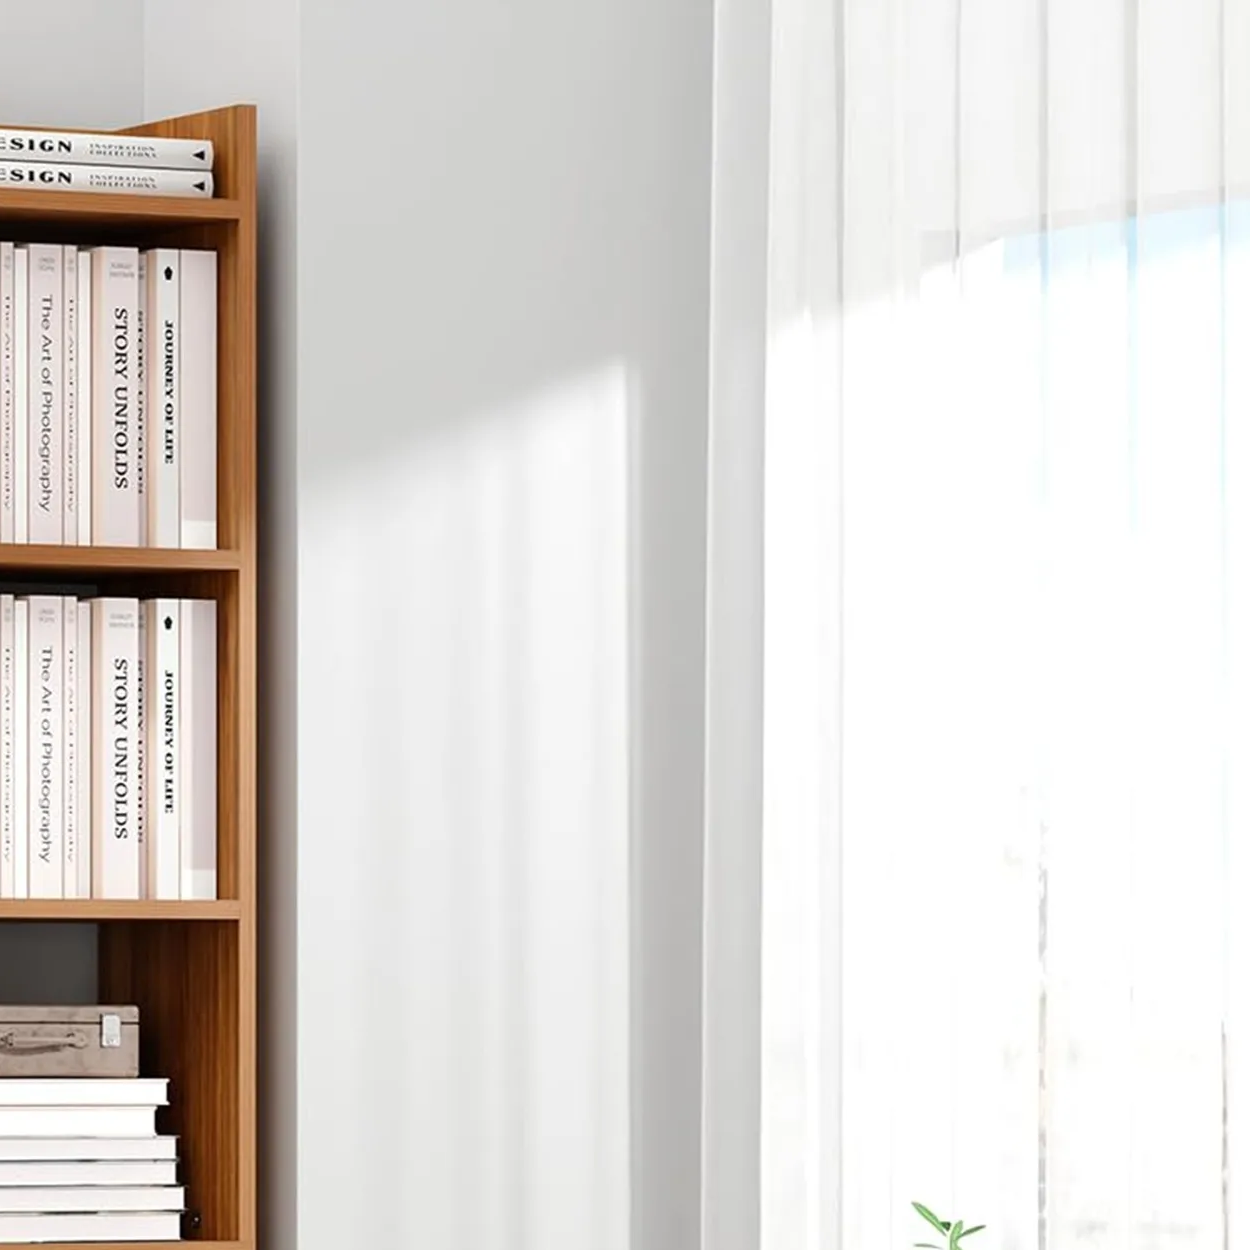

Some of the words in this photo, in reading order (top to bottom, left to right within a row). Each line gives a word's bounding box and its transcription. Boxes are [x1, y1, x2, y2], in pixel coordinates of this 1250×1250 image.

[41, 295, 53, 330] The
[41, 335, 53, 362] Art
[114, 308, 128, 379] STORY
[164, 320, 174, 397] JOURNEY
[41, 367, 53, 387] of
[164, 404, 174, 425] OF
[39, 391, 53, 512] Photography
[114, 387, 128, 489] UNFOLDS
[164, 430, 174, 464] LIFE
[41, 647, 53, 681] The
[41, 686, 53, 713] Art
[114, 658, 128, 729] STORY
[164, 670, 174, 748] JOURNEY
[41, 719, 53, 738] of
[164, 753, 174, 775] OF
[39, 743, 53, 863] Photography
[114, 737, 128, 839] UNFOLDS
[164, 779, 174, 814] LIFE
